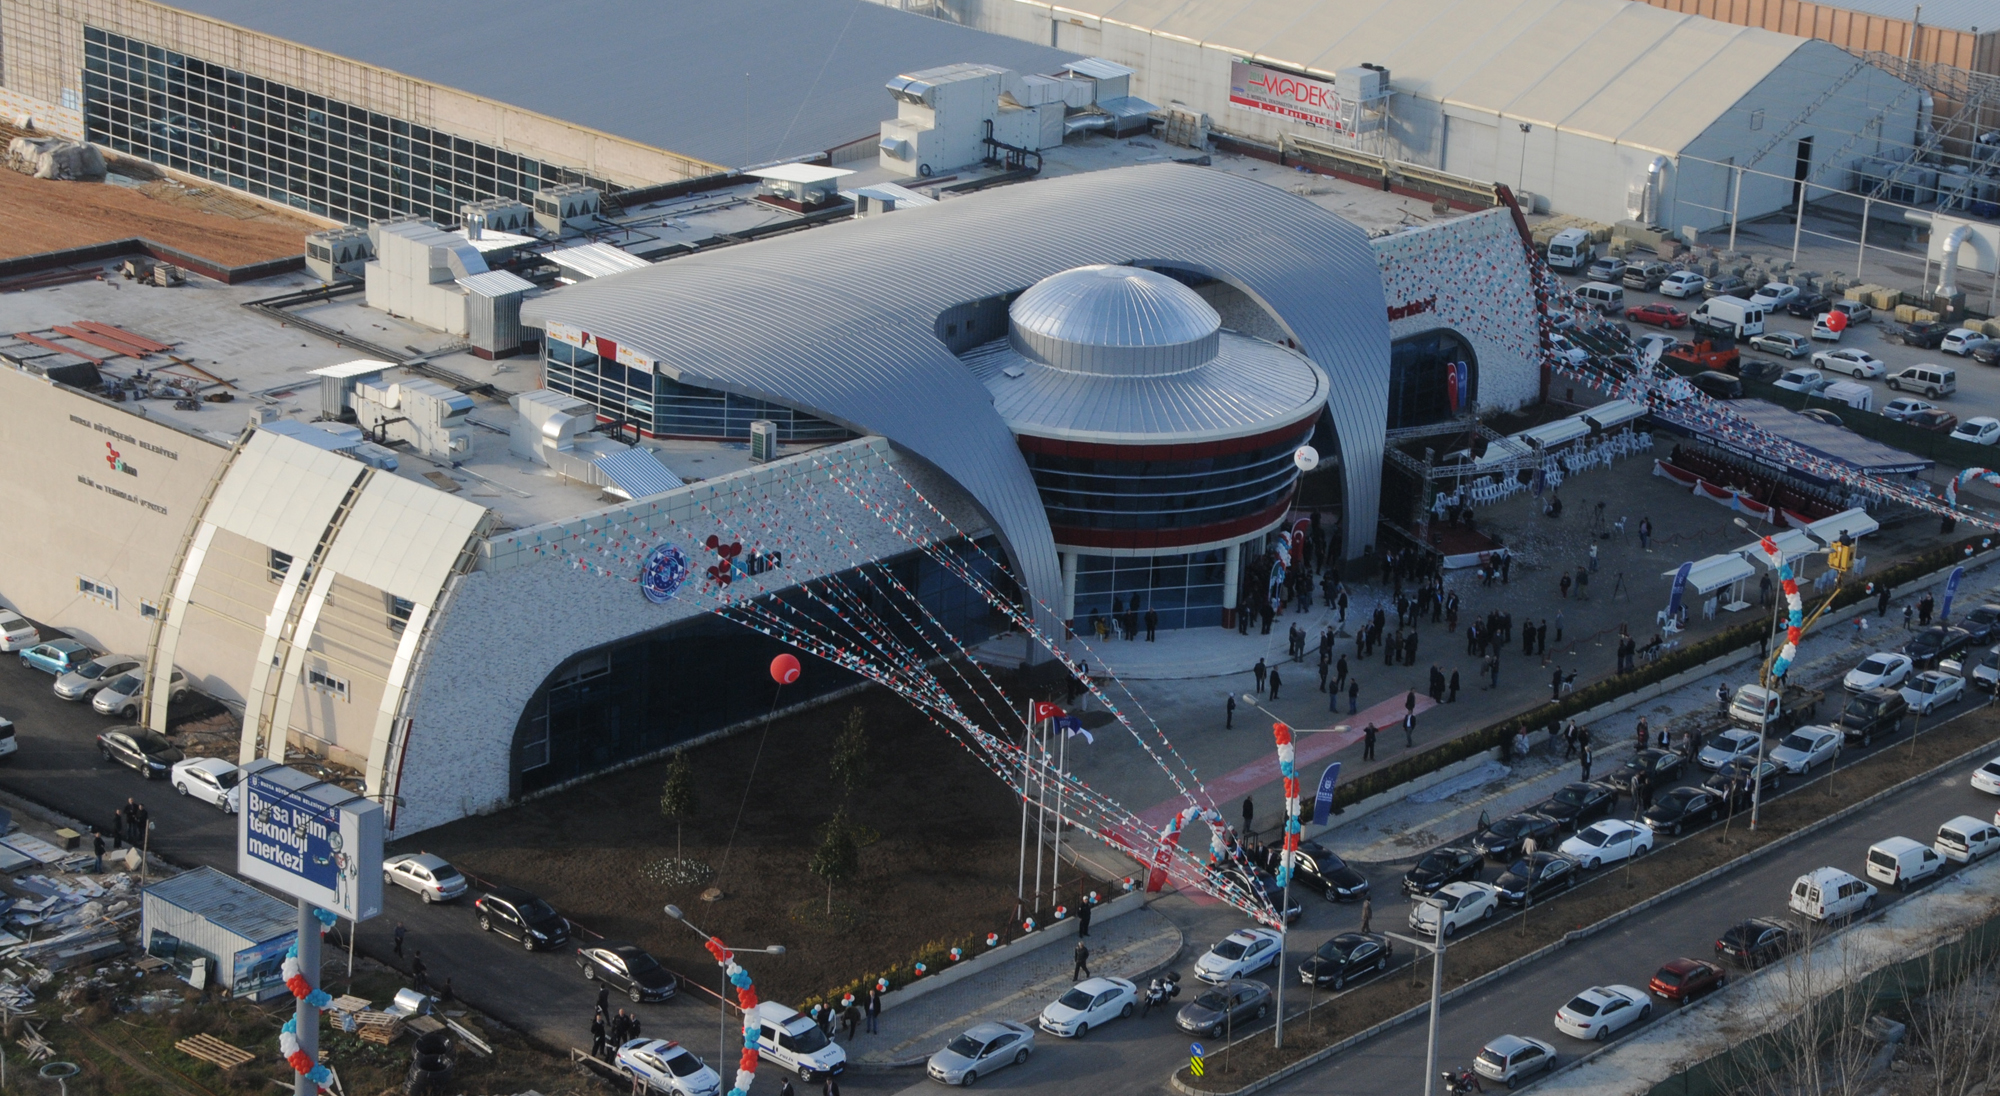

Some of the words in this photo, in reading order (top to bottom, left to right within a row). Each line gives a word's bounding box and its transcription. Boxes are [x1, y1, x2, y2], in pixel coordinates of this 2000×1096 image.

[1284, 108, 1302, 119] Mart
[70, 414, 92, 428] BURSA
[139, 440, 178, 460] BELEDİYESİ
[1696, 434, 1715, 446] BURSA
[78, 475, 94, 487] BİLİM
[260, 781, 274, 790] BURSA
[250, 792, 290, 825] Bursa
[292, 809, 327, 840] bilim
[249, 812, 308, 854] teknoloji
[249, 838, 304, 873] merkezi
